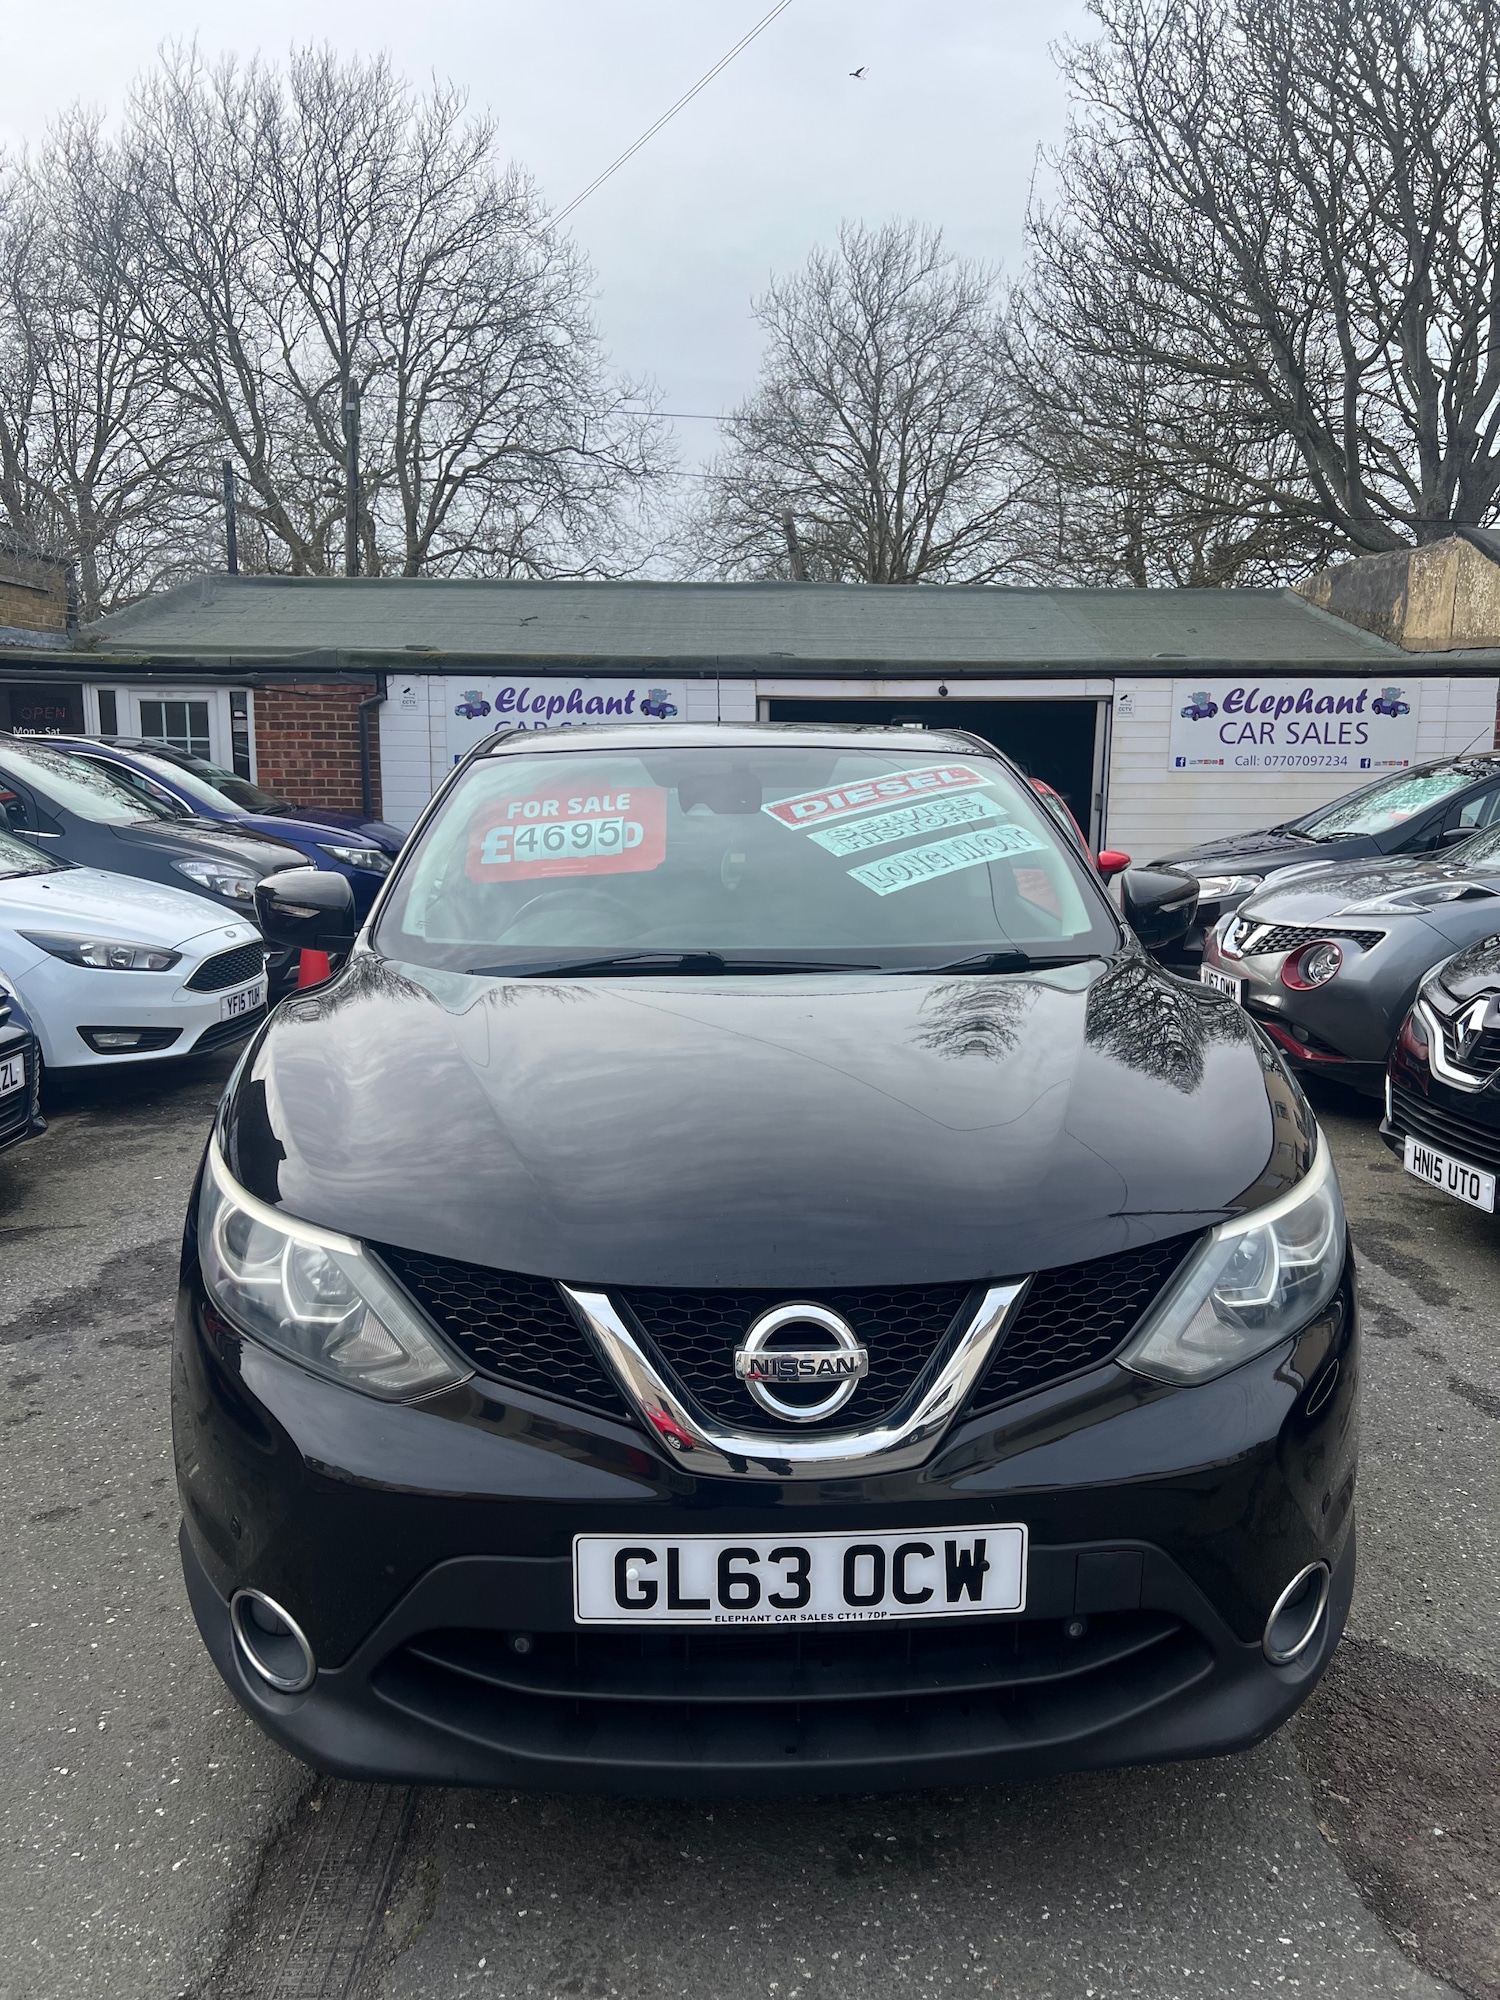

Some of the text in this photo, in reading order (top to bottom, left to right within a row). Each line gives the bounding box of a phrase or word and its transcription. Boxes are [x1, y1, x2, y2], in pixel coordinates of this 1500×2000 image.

[21, 706, 66, 720] OPEN
[494, 687, 636, 720] Elephant
[1222, 687, 1368, 720] Elephant
[12, 726, 36, 735] Mon
[45, 726, 61, 736] Sat
[1218, 721, 1370, 746] CAR SALES
[1234, 755, 1260, 767] Call:
[1264, 755, 1348, 767] 07707097234
[507, 793, 631, 820] FOR SALE
[790, 770, 970, 819] DIESEL
[826, 797, 976, 841] SERVICE
[838, 804, 986, 849] HISTORY
[858, 851, 953, 888] LONG
[227, 992, 246, 1015] YF15
[0, 1062, 18, 1092] ZL
[1413, 1145, 1443, 1183] HN15
[1448, 1163, 1480, 1201] UTO
[750, 1356, 855, 1375] NISSAN
[614, 1538, 987, 1611] GL63 OCW
[714, 1611, 888, 1623] ELEPHANT CAR SALES CT11 7DP
